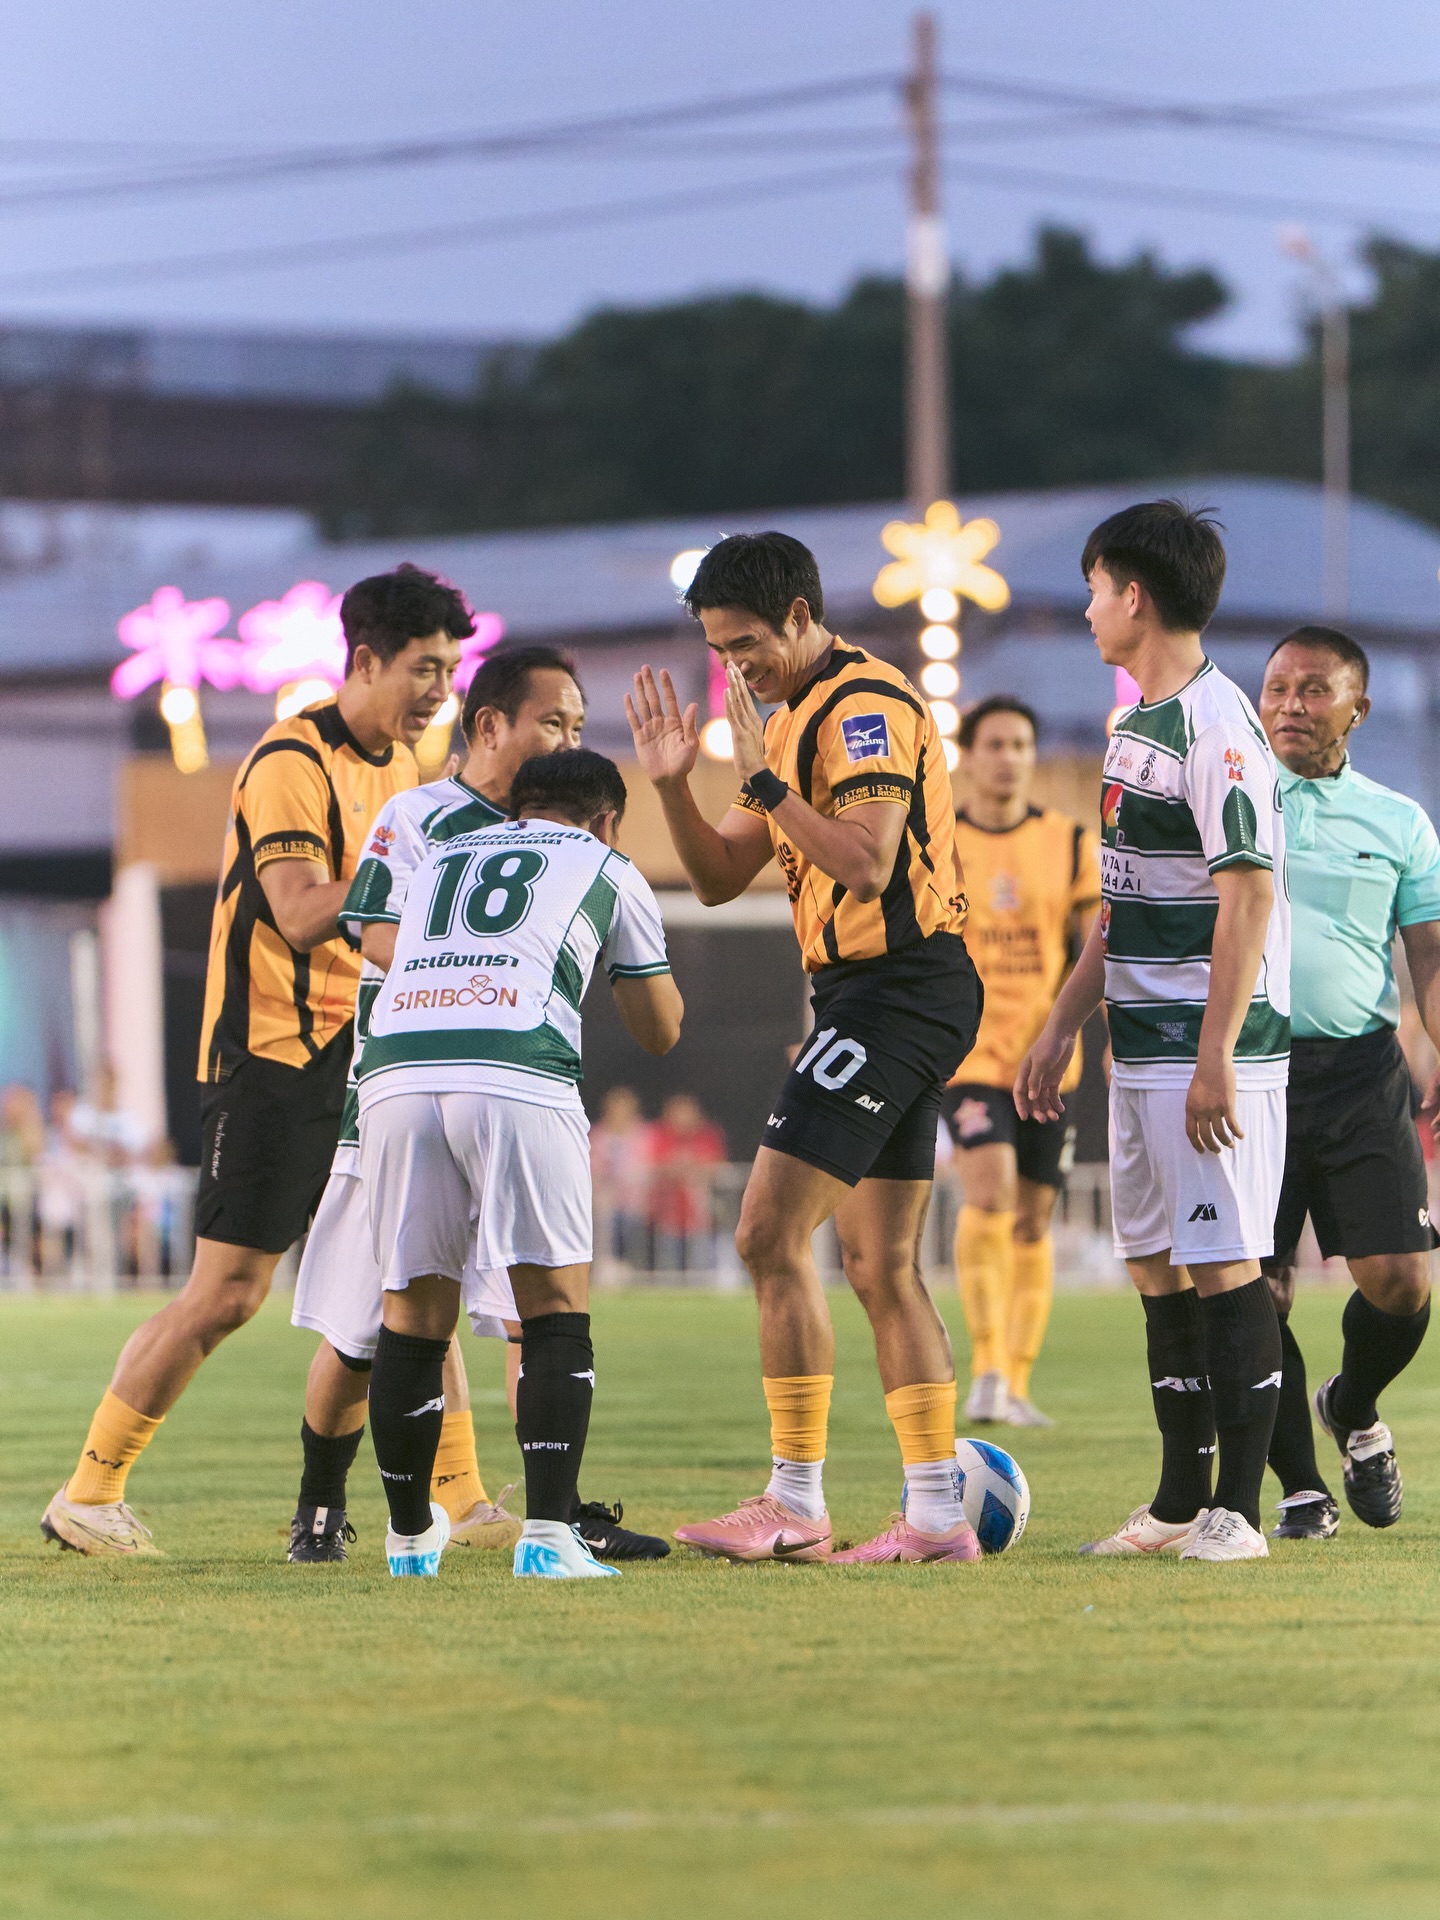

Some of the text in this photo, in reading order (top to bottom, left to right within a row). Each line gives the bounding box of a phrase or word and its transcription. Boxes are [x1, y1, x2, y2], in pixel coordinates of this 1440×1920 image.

[844, 785, 901, 797] STAR STAR
[845, 791, 902, 805] RIDER RIDER
[424, 849, 548, 941] 18
[404, 952, 519, 972] ฉะเชิงเทรา
[392, 987, 518, 1012] SIRIBOON
[796, 1026, 867, 1090] 10
[855, 1094, 885, 1113] Ari
[531, 1442, 570, 1451] SPORT
